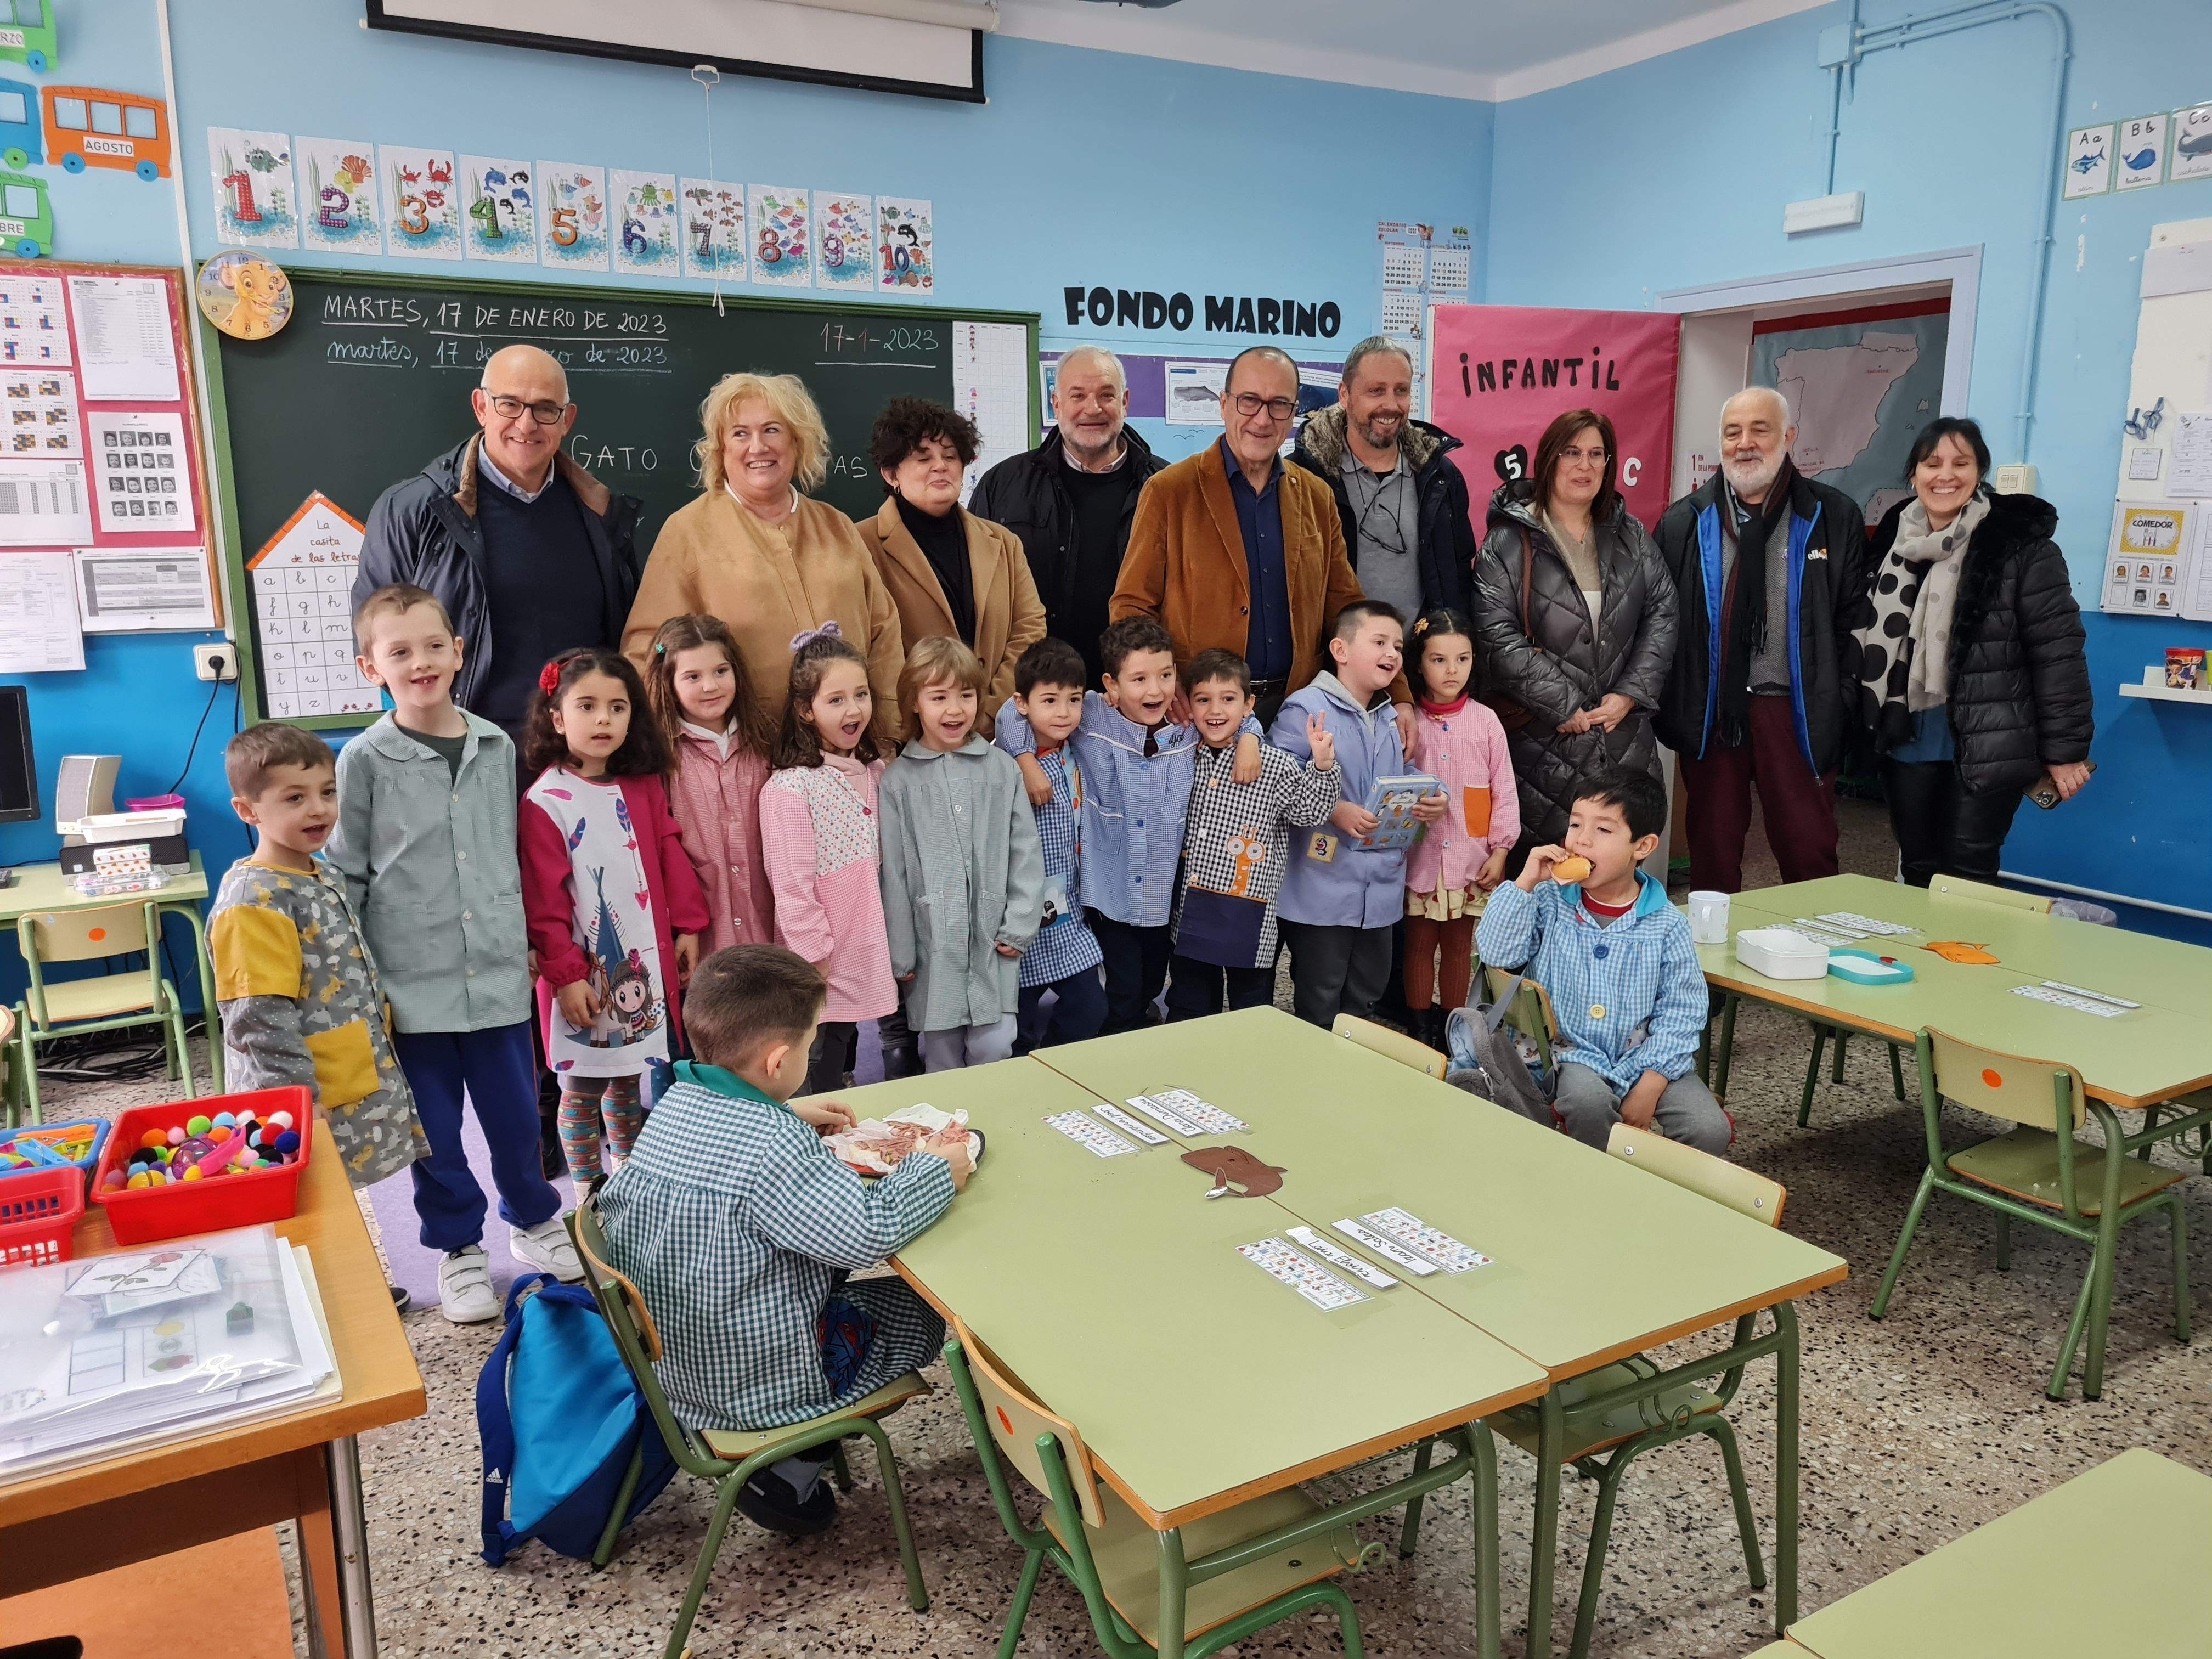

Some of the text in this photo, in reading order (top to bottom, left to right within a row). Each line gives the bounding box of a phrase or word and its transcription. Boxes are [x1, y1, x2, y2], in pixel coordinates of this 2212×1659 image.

[85, 139, 133, 155] AGOSTO
[222, 173, 262, 221] 1
[318, 188, 349, 228] 2
[399, 198, 429, 234] 3
[469, 196, 503, 239] 4
[551, 207, 577, 246] 5
[622, 219, 647, 254] 6
[690, 221, 712, 257] 7
[758, 228, 782, 263] 8
[823, 235, 844, 267] 9
[879, 245, 909, 272] 10
[324, 295, 667, 334] MARTES, 17 DE ENERO DE 2023
[1064, 286, 1341, 338] FONDO MARINO
[327, 336, 419, 368] martes,
[437, 343, 458, 365] 17
[585, 343, 606, 363] de
[616, 345, 667, 365] 2023
[571, 435, 658, 471] GATO
[1504, 454, 1522, 480] 5
[1622, 457, 1641, 487] C
[317, 520, 330, 530] La
[2132, 520, 2173, 529] COMEDOR
[310, 537, 340, 546] casita
[291, 551, 360, 563] de las letras
[264, 577, 275, 585] a
[295, 571, 306, 584] b
[327, 575, 336, 583] c
[269, 597, 277, 616] f
[327, 595, 341, 608] h
[325, 623, 348, 633] m
[278, 702, 290, 715] y
[1334, 1255, 1370, 1278] Elvira
[1388, 1246, 1417, 1265] Izan
